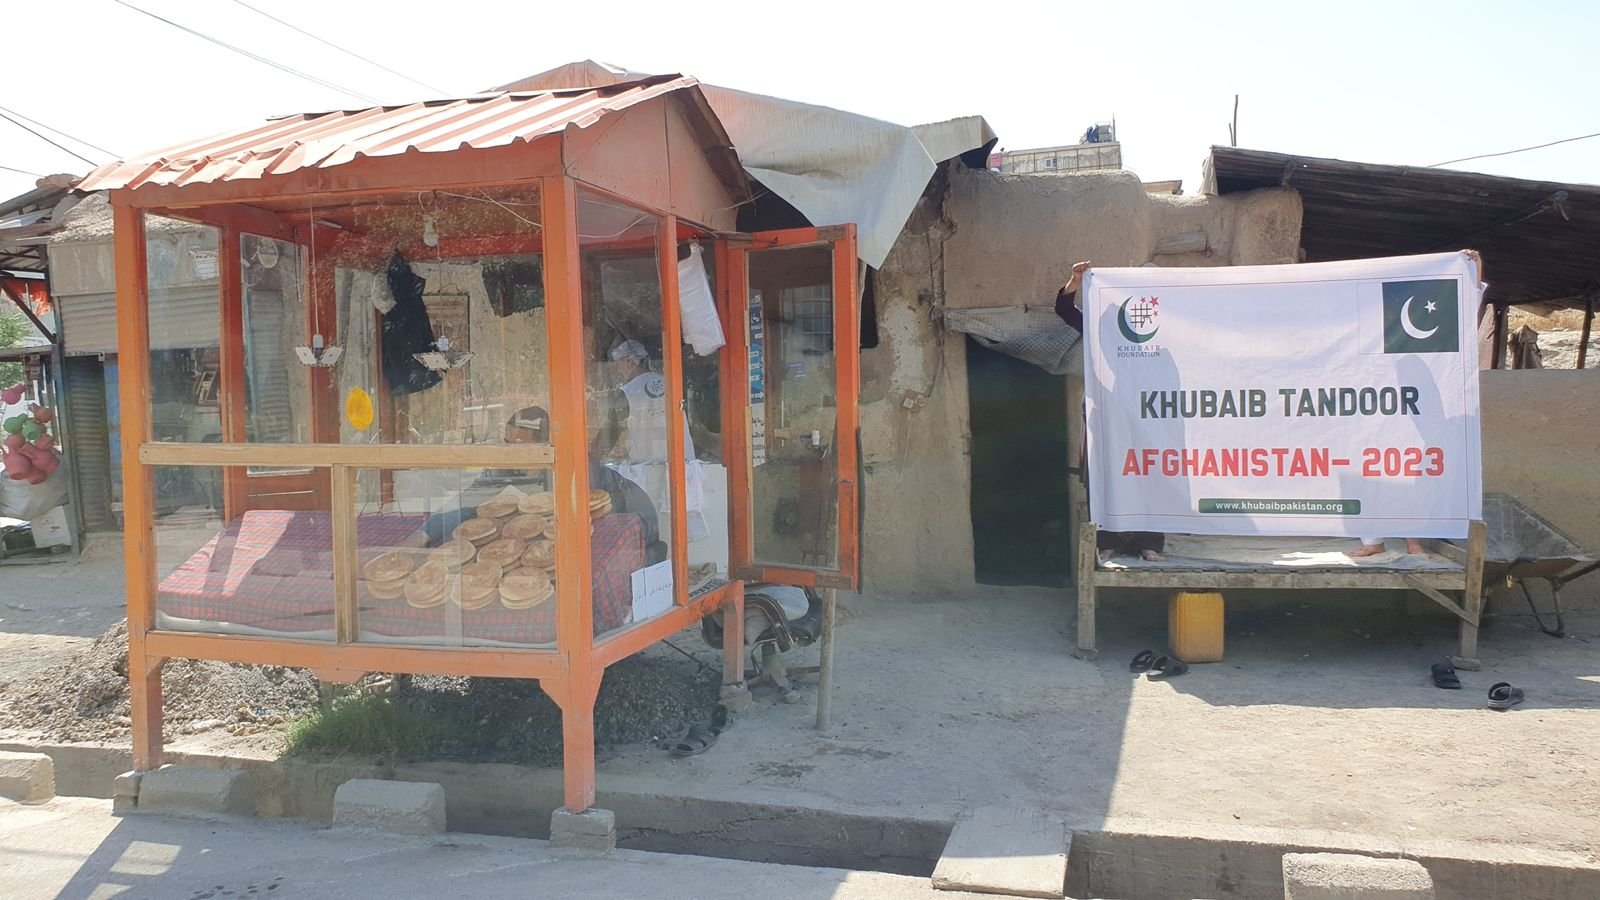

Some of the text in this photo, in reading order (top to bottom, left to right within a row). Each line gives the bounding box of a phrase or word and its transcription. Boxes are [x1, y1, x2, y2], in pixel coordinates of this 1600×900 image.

[1140, 386, 1420, 419] KHUBAIB TANDOOR
[1362, 447, 1445, 477] 2023
[1215, 501, 1343, 512] www.khubaibpakistan.org
